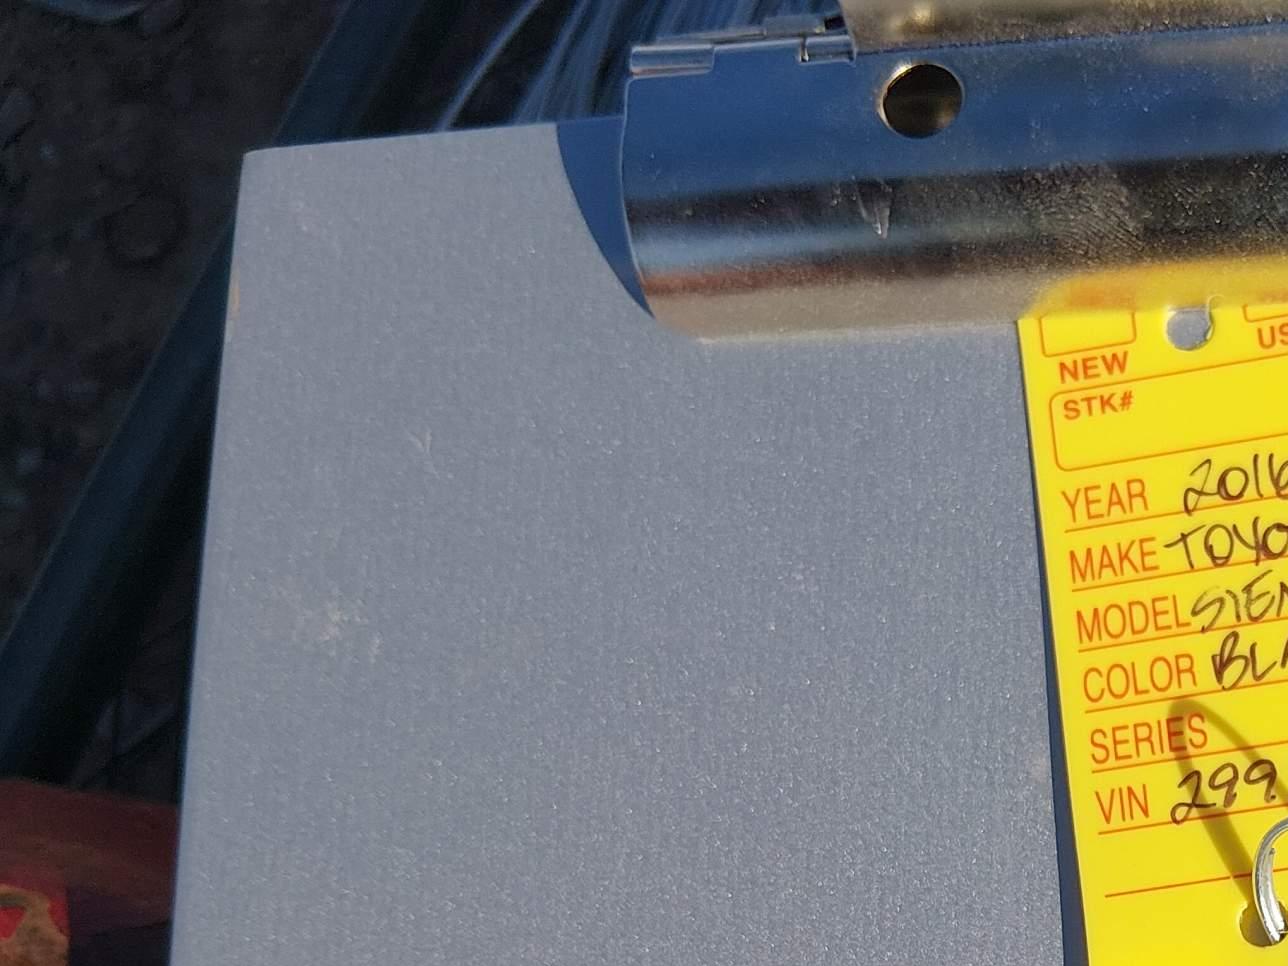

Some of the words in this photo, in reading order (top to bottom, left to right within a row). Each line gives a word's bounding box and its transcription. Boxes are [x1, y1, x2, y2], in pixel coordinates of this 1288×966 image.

[1058, 350, 1130, 384] NEW
[1063, 390, 1134, 420] STK#
[1061, 478, 1149, 523] YEAR
[1069, 536, 1160, 584] MAKE
[1075, 595, 1191, 644] MODEL
[1082, 653, 1197, 703] COLOR
[1090, 713, 1208, 764] SERIES
[1095, 783, 1150, 825] VIN
